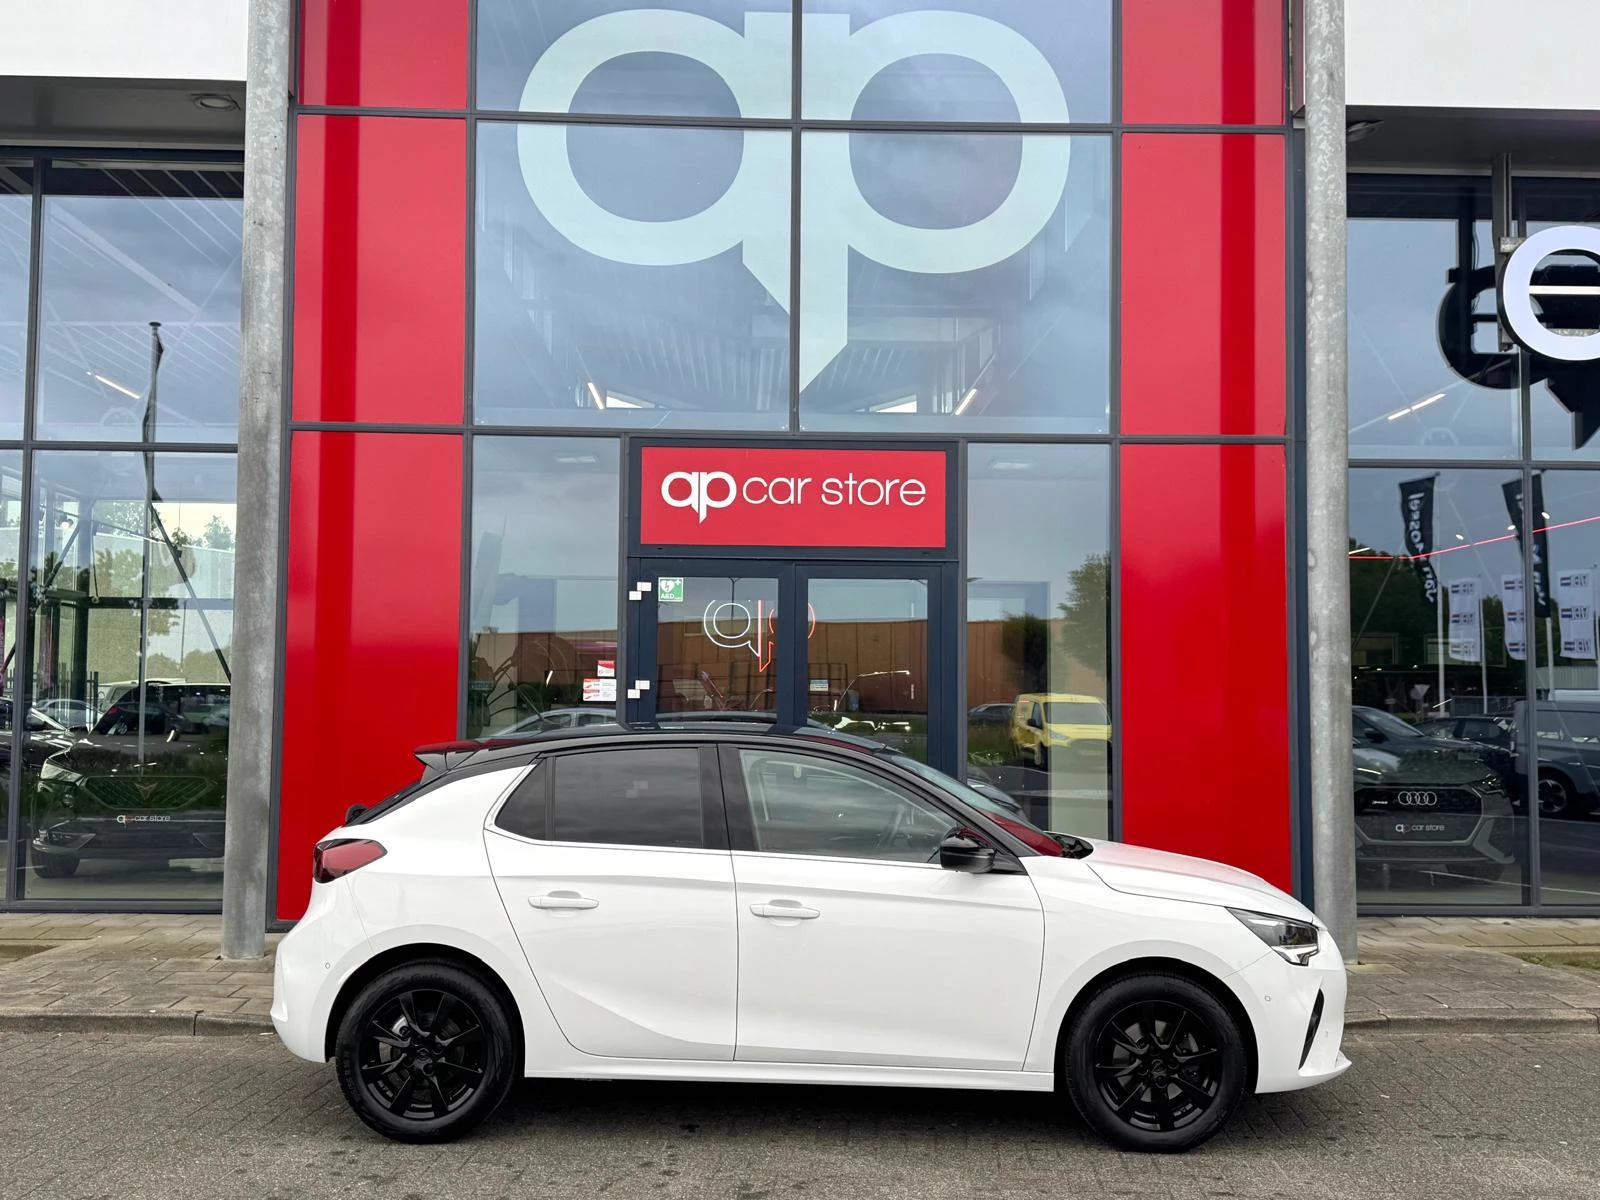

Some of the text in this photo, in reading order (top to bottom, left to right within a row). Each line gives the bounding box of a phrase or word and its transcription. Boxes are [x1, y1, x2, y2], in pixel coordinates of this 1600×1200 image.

[661, 471, 927, 524] ap car store
[149, 814, 171, 822] store
